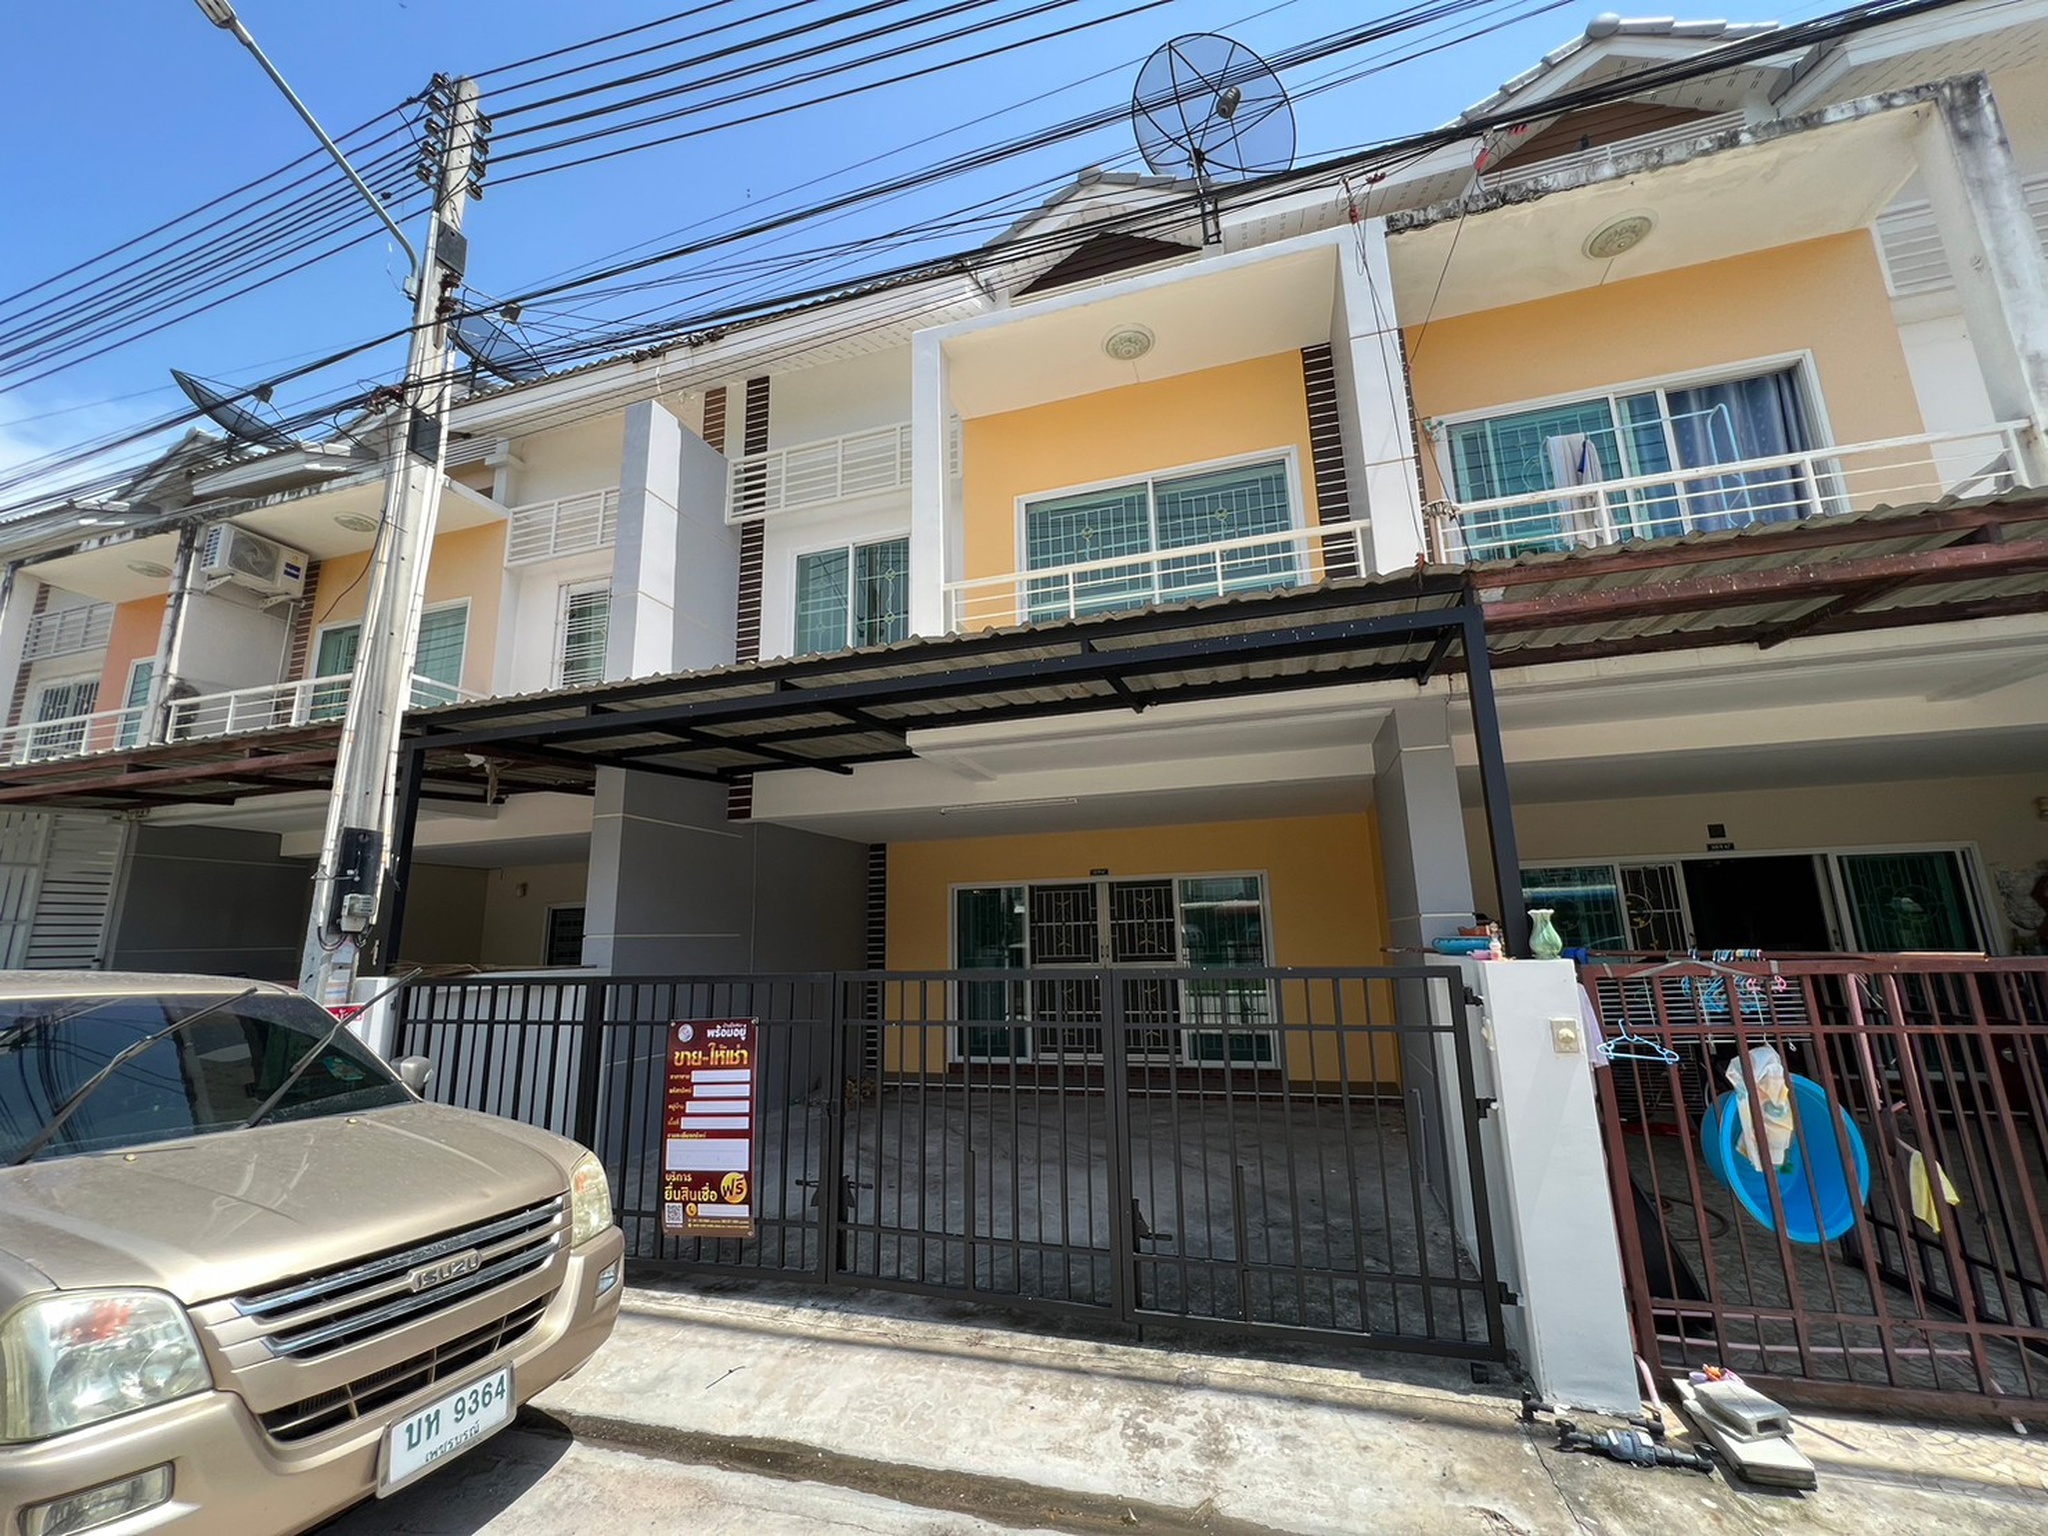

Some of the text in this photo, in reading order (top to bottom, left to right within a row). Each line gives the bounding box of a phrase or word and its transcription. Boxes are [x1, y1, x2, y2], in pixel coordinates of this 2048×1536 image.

[707, 1024, 747, 1041] พร้อมอยู่
[665, 1171, 693, 1182] บริการ
[664, 1182, 718, 1202] ยื่นสินเชื่อ
[722, 1177, 744, 1197] ฟรี
[413, 1255, 479, 1290] ISUZU
[453, 1374, 506, 1424] 9364
[425, 1419, 480, 1462] เพชรบรณ์
